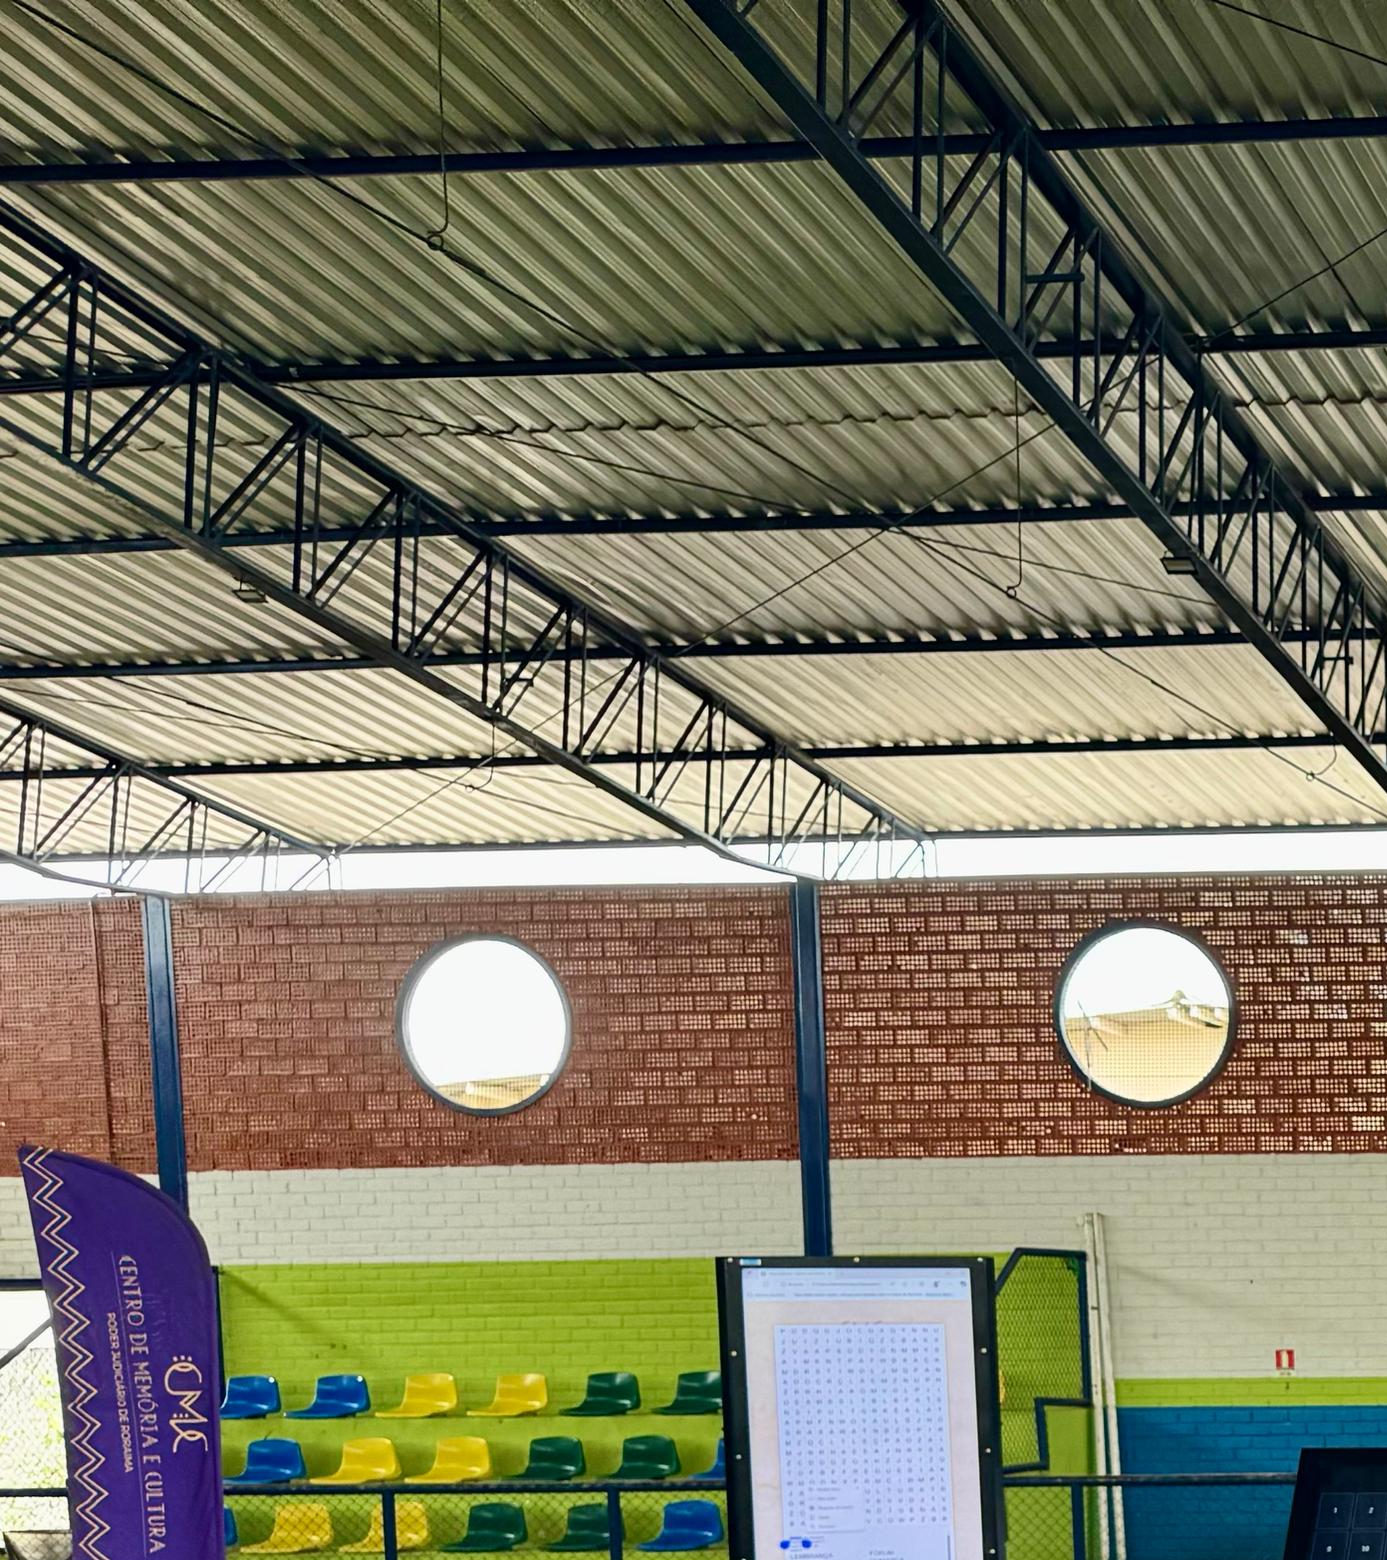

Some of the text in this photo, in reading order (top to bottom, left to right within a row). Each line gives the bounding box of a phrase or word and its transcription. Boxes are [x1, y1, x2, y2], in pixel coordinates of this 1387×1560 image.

[107, 1312, 120, 1350] PODER
[117, 1409, 130, 1424] DE
[118, 1255, 167, 1553] CENTRO DE MEMÓRIA E CULTURA
